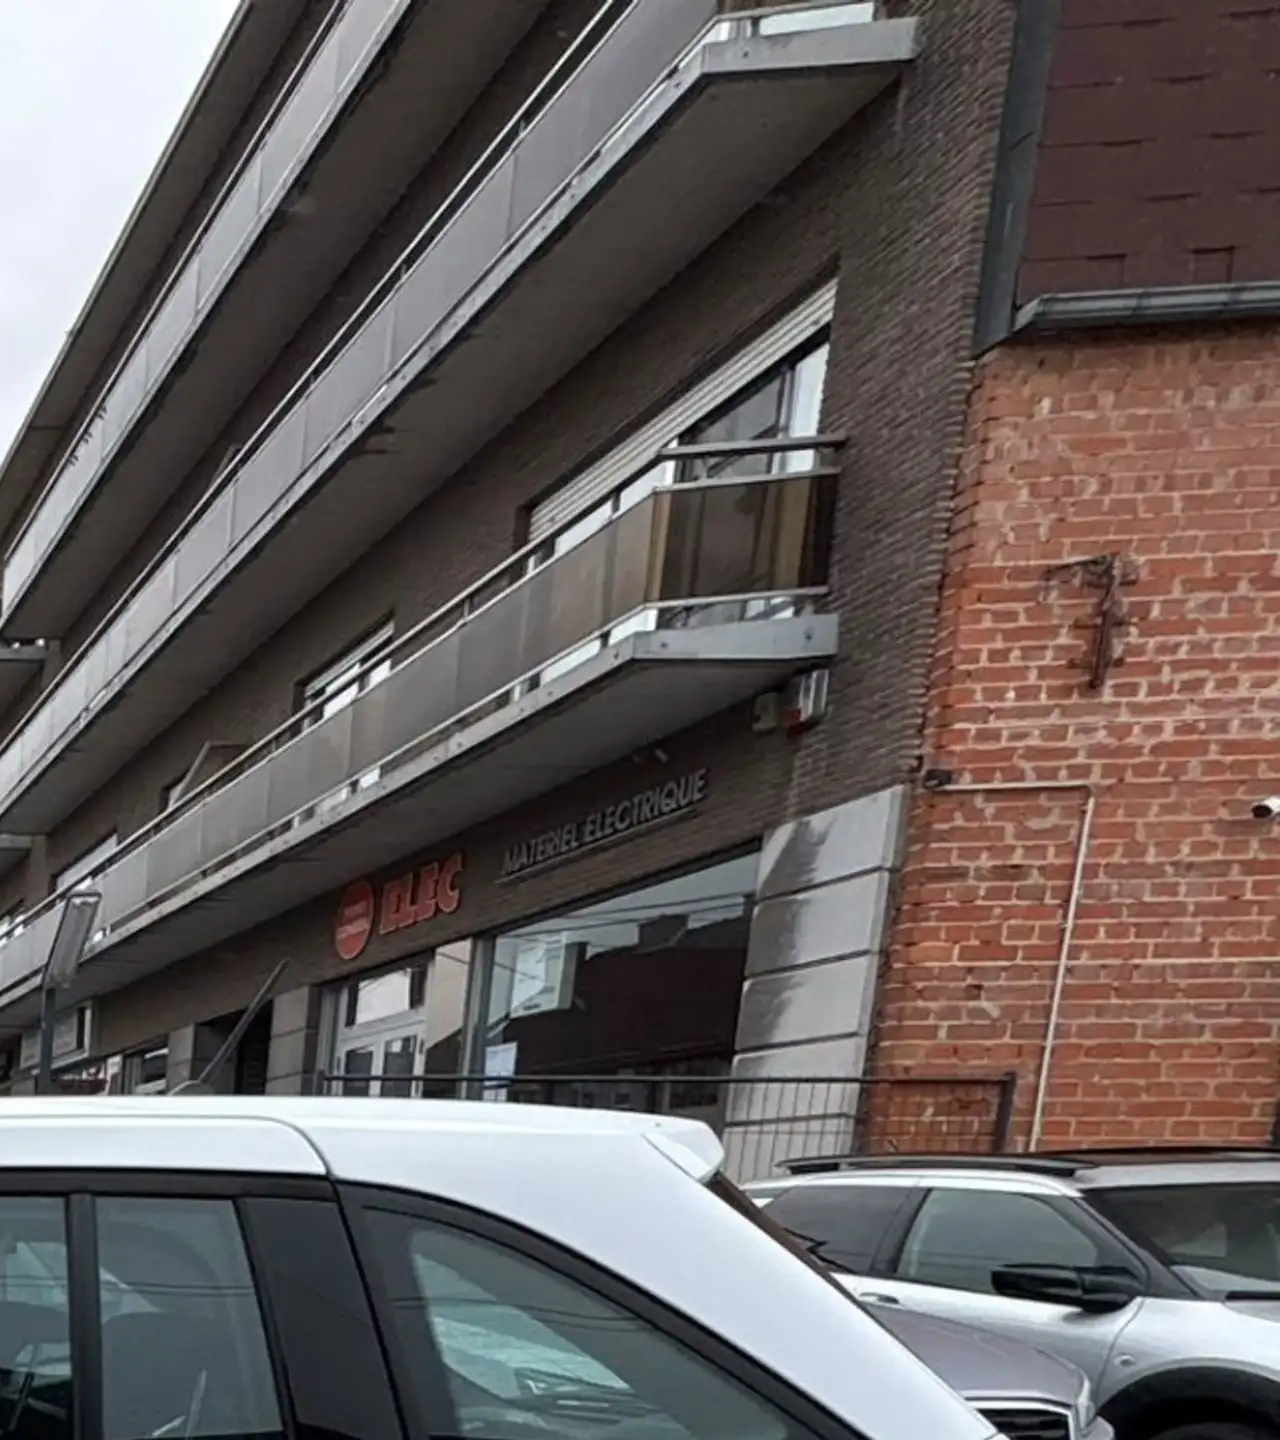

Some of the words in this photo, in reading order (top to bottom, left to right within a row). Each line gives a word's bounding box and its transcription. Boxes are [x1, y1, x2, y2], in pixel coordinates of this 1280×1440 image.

[502, 826, 580, 874] MATERIEL
[584, 768, 708, 841] ELECTRIQUE
[379, 853, 463, 935] ELEC
